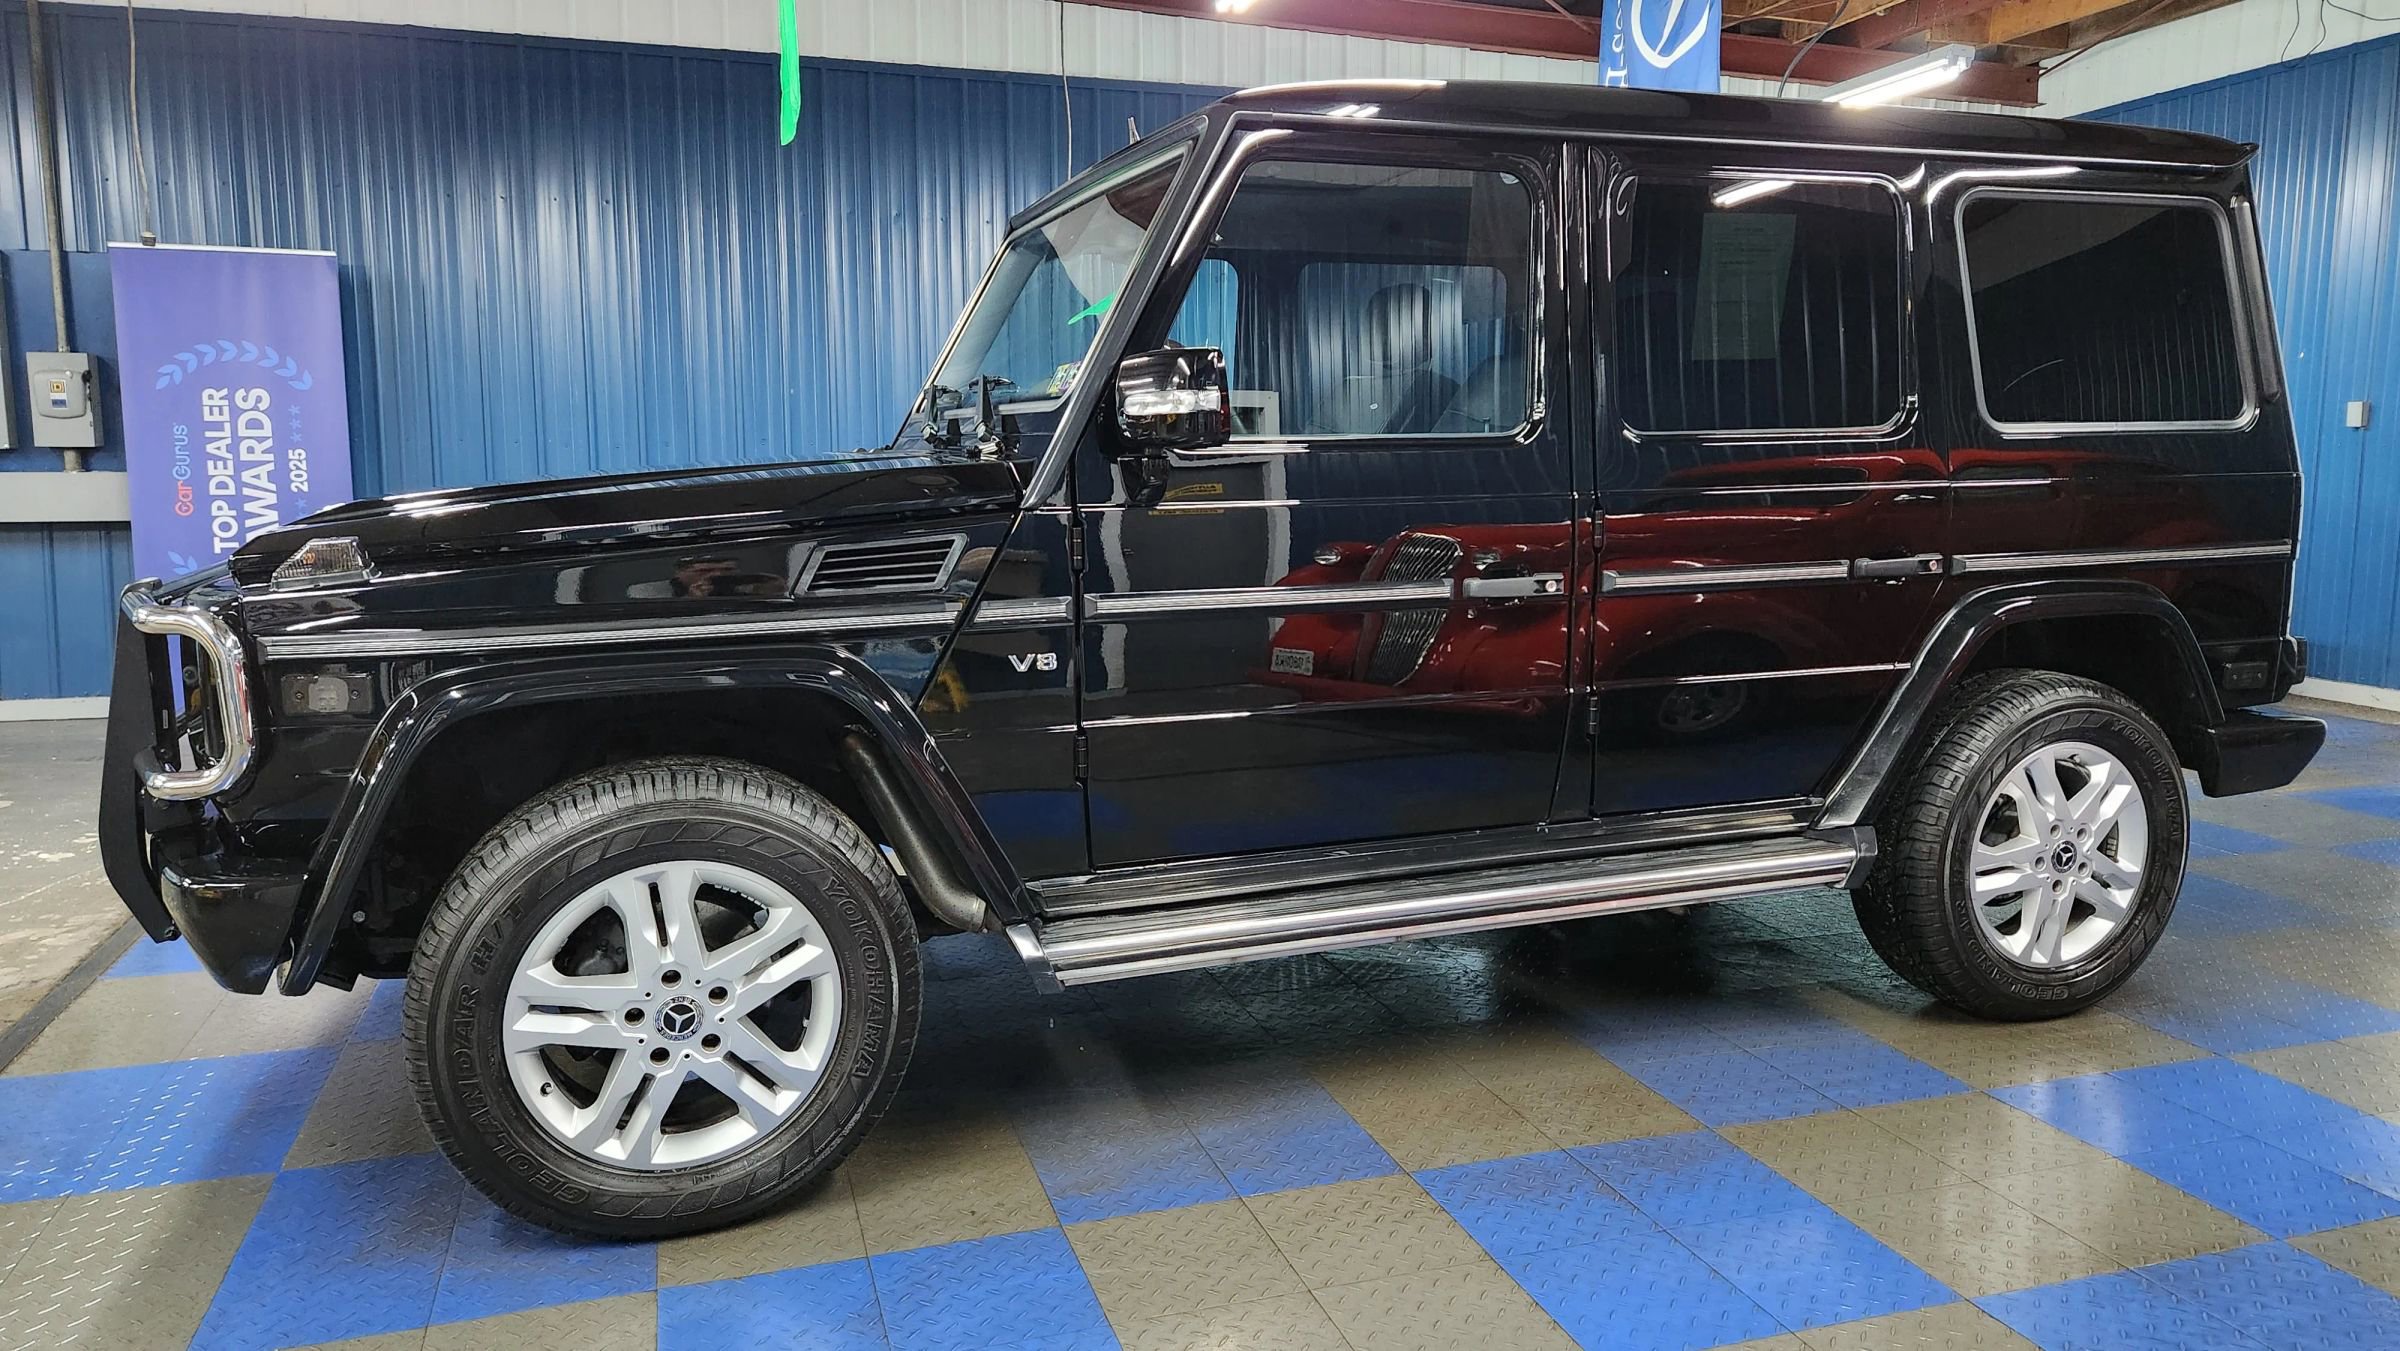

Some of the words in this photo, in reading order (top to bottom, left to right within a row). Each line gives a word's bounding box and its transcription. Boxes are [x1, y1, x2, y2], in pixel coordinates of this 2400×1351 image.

[173, 425, 194, 516] CarGurus
[202, 387, 236, 496] DEALER
[288, 448, 309, 493] 2025
[211, 499, 240, 554] TOP
[1007, 652, 1058, 672] V8
[470, 892, 525, 976] H/T
[822, 876, 886, 1078] YOKOHAMA
[452, 983, 591, 1204] GEOLANDAR
